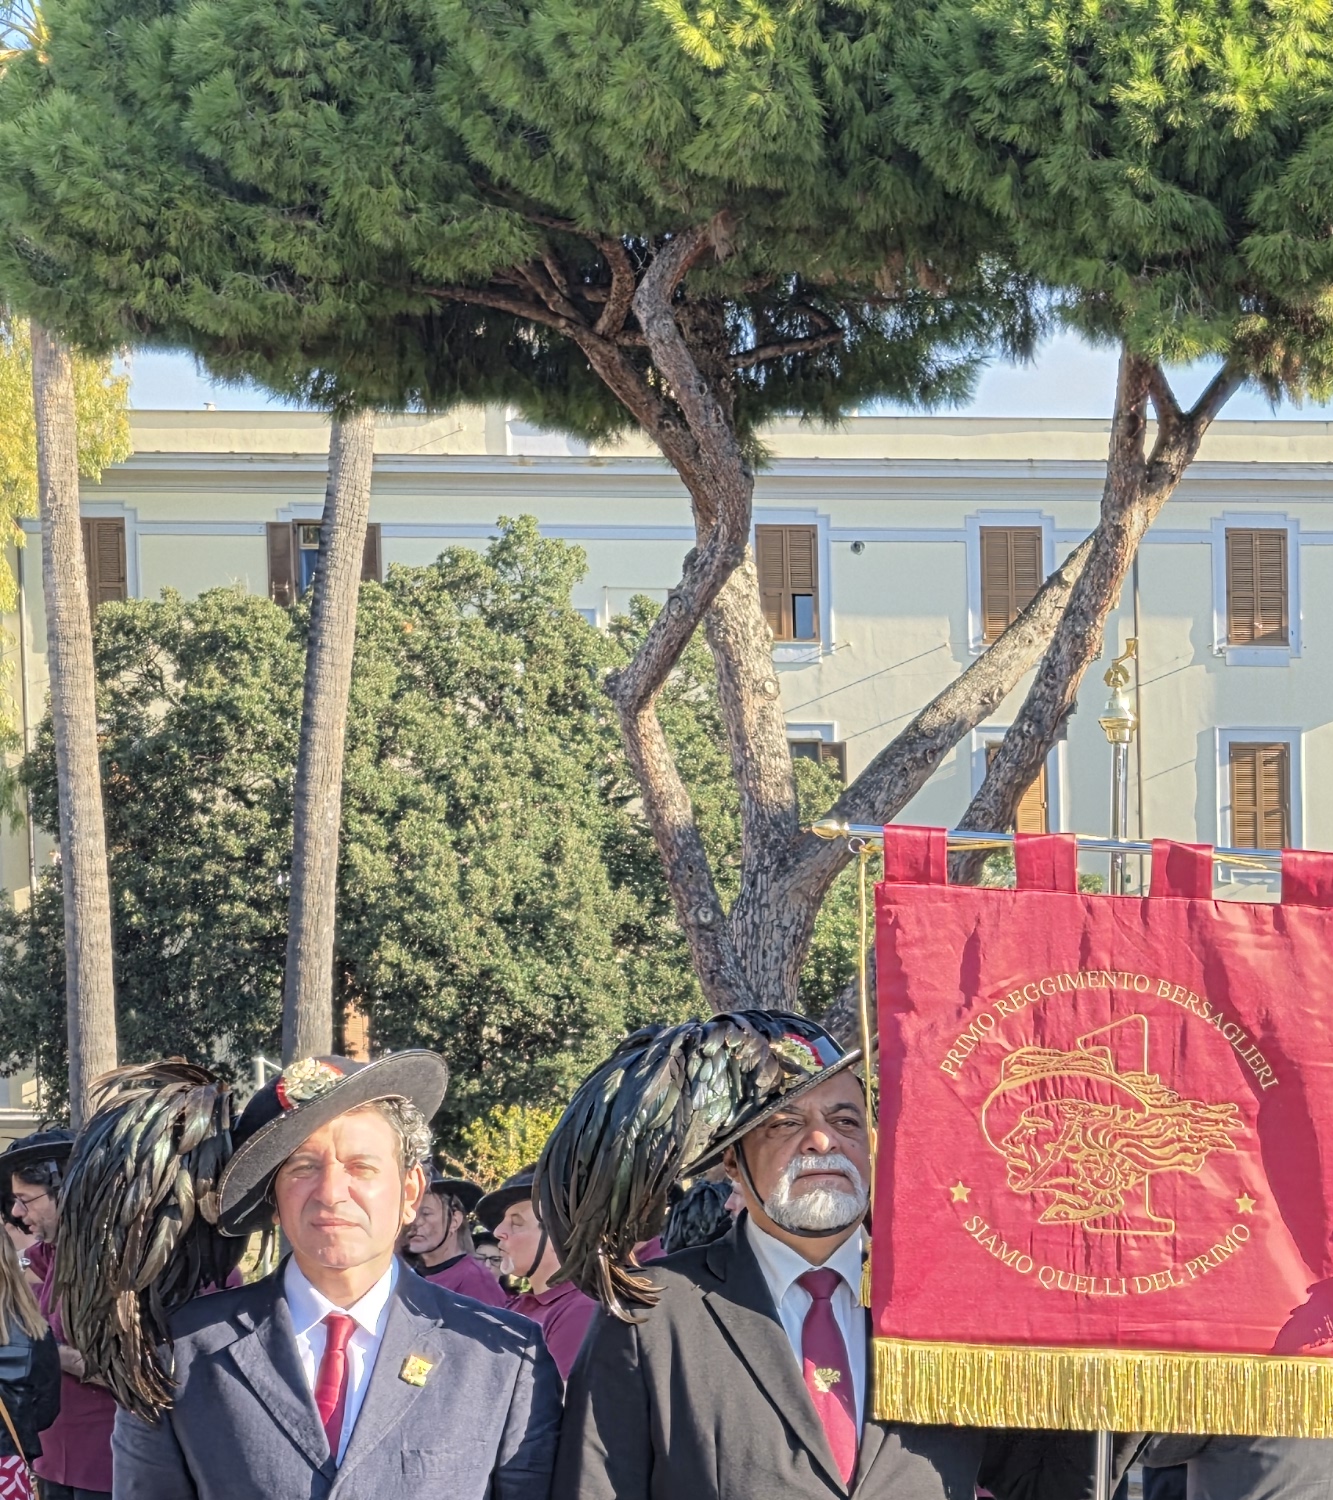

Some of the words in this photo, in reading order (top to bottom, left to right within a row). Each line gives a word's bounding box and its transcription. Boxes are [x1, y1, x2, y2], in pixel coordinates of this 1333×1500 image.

[939, 1013, 995, 1078] PRIMO
[994, 970, 1150, 1018] REGGIMENTO
[1156, 978, 1280, 1092] BERSAGLIERI
[964, 1215, 1033, 1274] SIAMO
[1038, 1265, 1128, 1296] QUELLI
[1132, 1269, 1184, 1294] DEL
[1184, 1223, 1251, 1279] PRIMO
